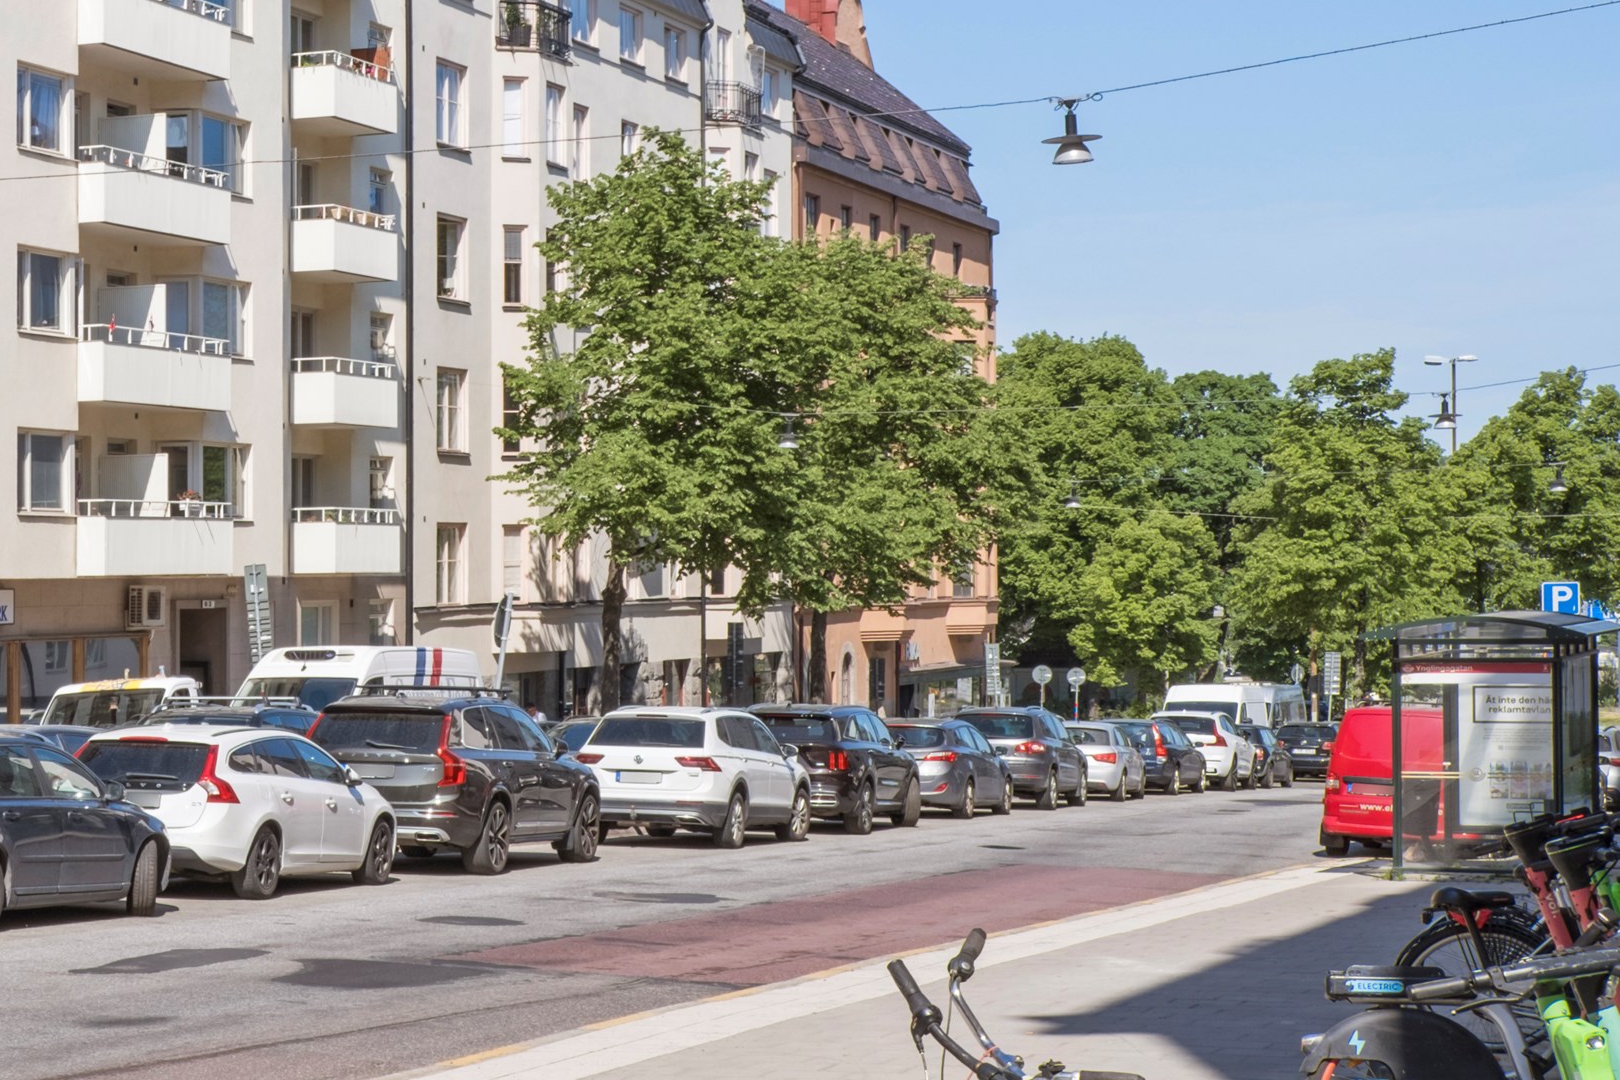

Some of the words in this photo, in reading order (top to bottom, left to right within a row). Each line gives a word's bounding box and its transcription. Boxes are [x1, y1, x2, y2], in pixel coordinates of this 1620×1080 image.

[1552, 585, 1573, 612] P
[1498, 695, 1516, 704] inte
[1518, 695, 1536, 704] den
[1357, 982, 1399, 991] ELECTRIC
